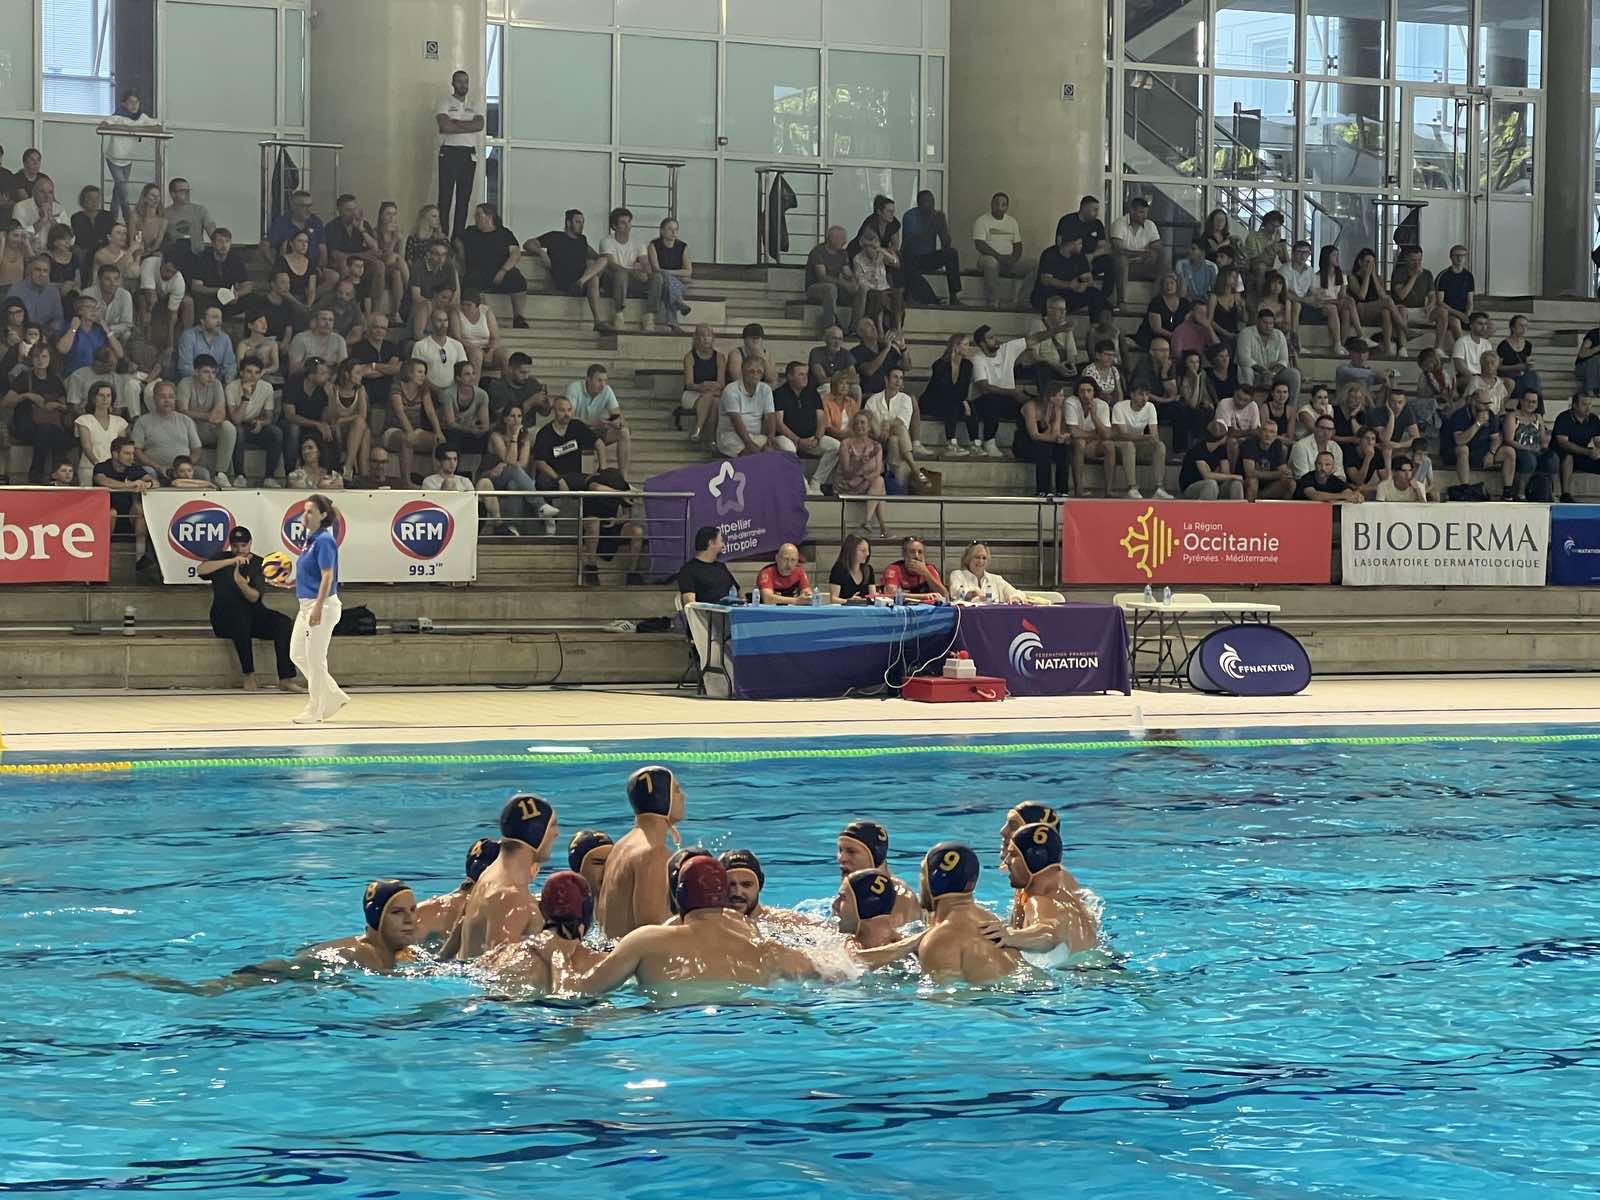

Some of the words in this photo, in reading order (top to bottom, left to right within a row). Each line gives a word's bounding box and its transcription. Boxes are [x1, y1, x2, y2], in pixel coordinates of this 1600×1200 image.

[179, 523, 224, 542] RFM
[401, 522, 443, 541] RFM
[1183, 522, 1193, 530] La
[0, 512, 95, 561] bre
[1183, 532, 1280, 551] Occitanie
[1354, 521, 1539, 552] BIODERMA
[409, 565, 435, 576] 99.3
[1354, 558, 1429, 568] LABORATOIRE
[1035, 656, 1099, 670] NATATION
[1238, 663, 1295, 673] FFNATATION
[639, 772, 653, 793] 7
[518, 798, 542, 820] 11
[1033, 825, 1049, 845] 6
[940, 850, 960, 872] 9
[870, 875, 888, 895] 5
